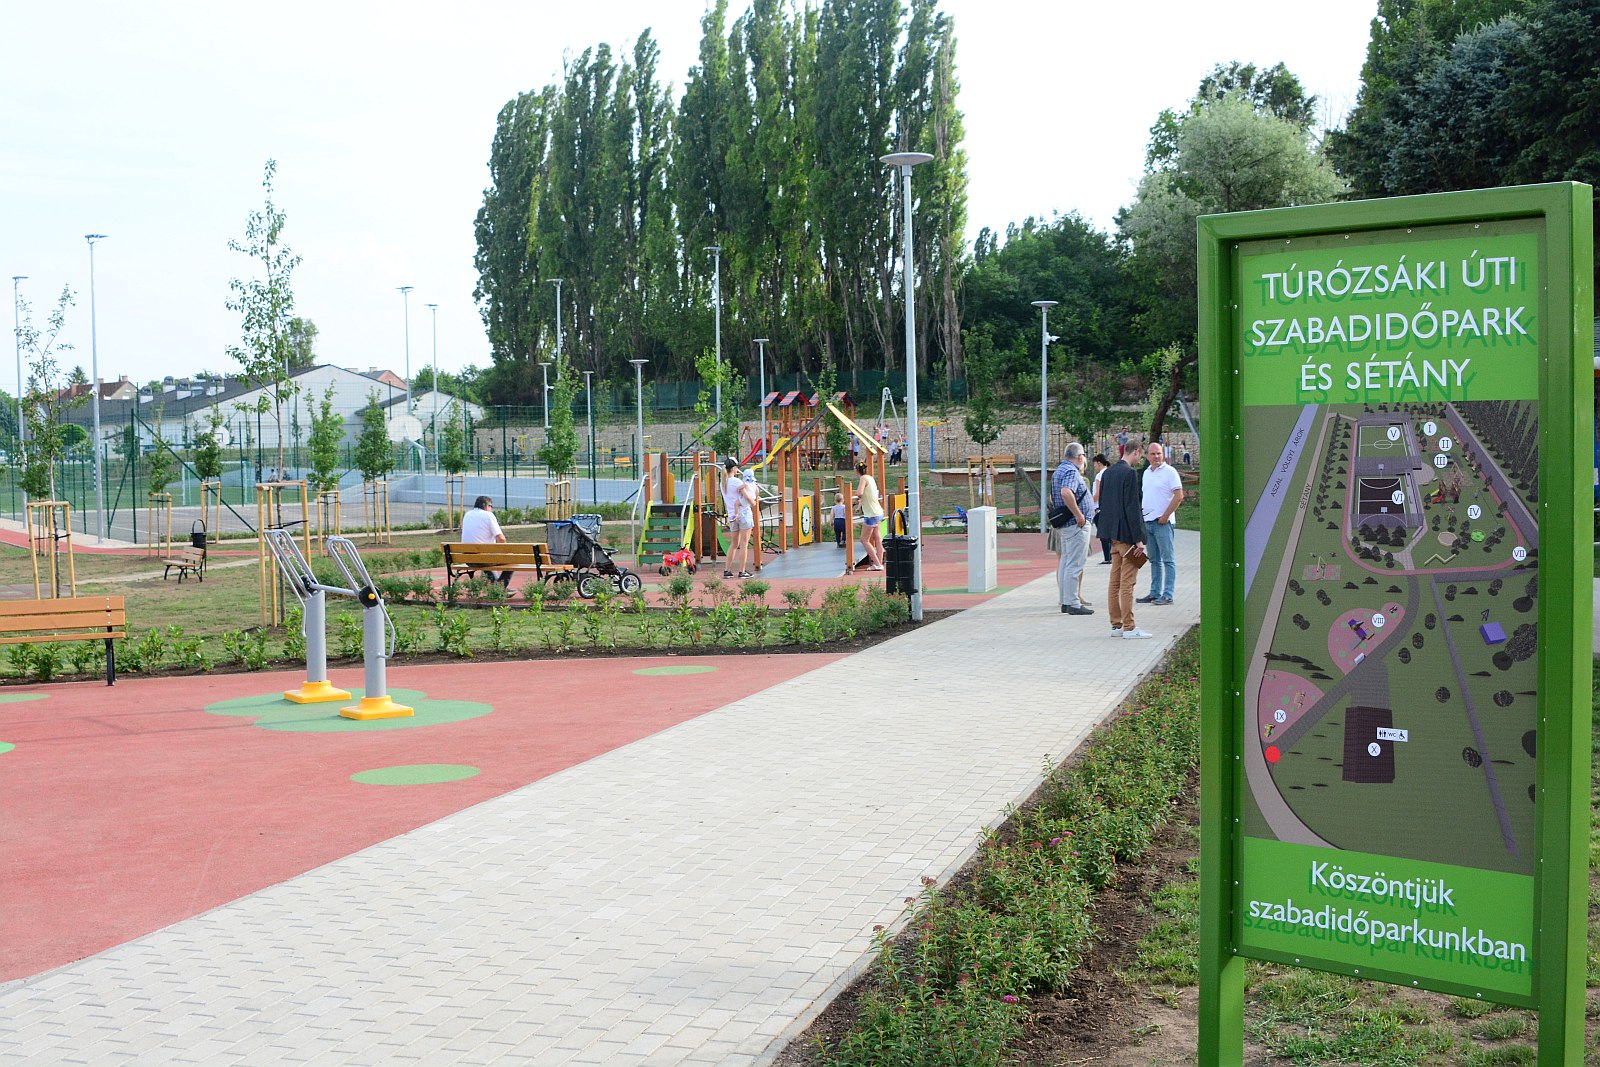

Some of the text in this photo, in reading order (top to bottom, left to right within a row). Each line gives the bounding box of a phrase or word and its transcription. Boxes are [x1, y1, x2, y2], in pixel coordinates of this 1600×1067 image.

[1261, 249, 1516, 300] TÚRÓZSÁKI ÚTI
[1251, 301, 1527, 347] SZABADIDŐPARK
[1301, 351, 1471, 391] ÉS SÉTÁNY
[1292, 427, 1305, 447] ÁROK
[1389, 429, 1397, 438] V
[1441, 439, 1450, 449] II
[1436, 456, 1446, 466] III
[1393, 493, 1403, 502] VI
[1469, 507, 1480, 517] IV
[1513, 549, 1525, 558] VII
[1276, 712, 1285, 721] IX
[1371, 745, 1378, 754] X
[1311, 860, 1455, 909] Köszöntjük
[1249, 898, 1526, 963] szabadidőparkunkban
